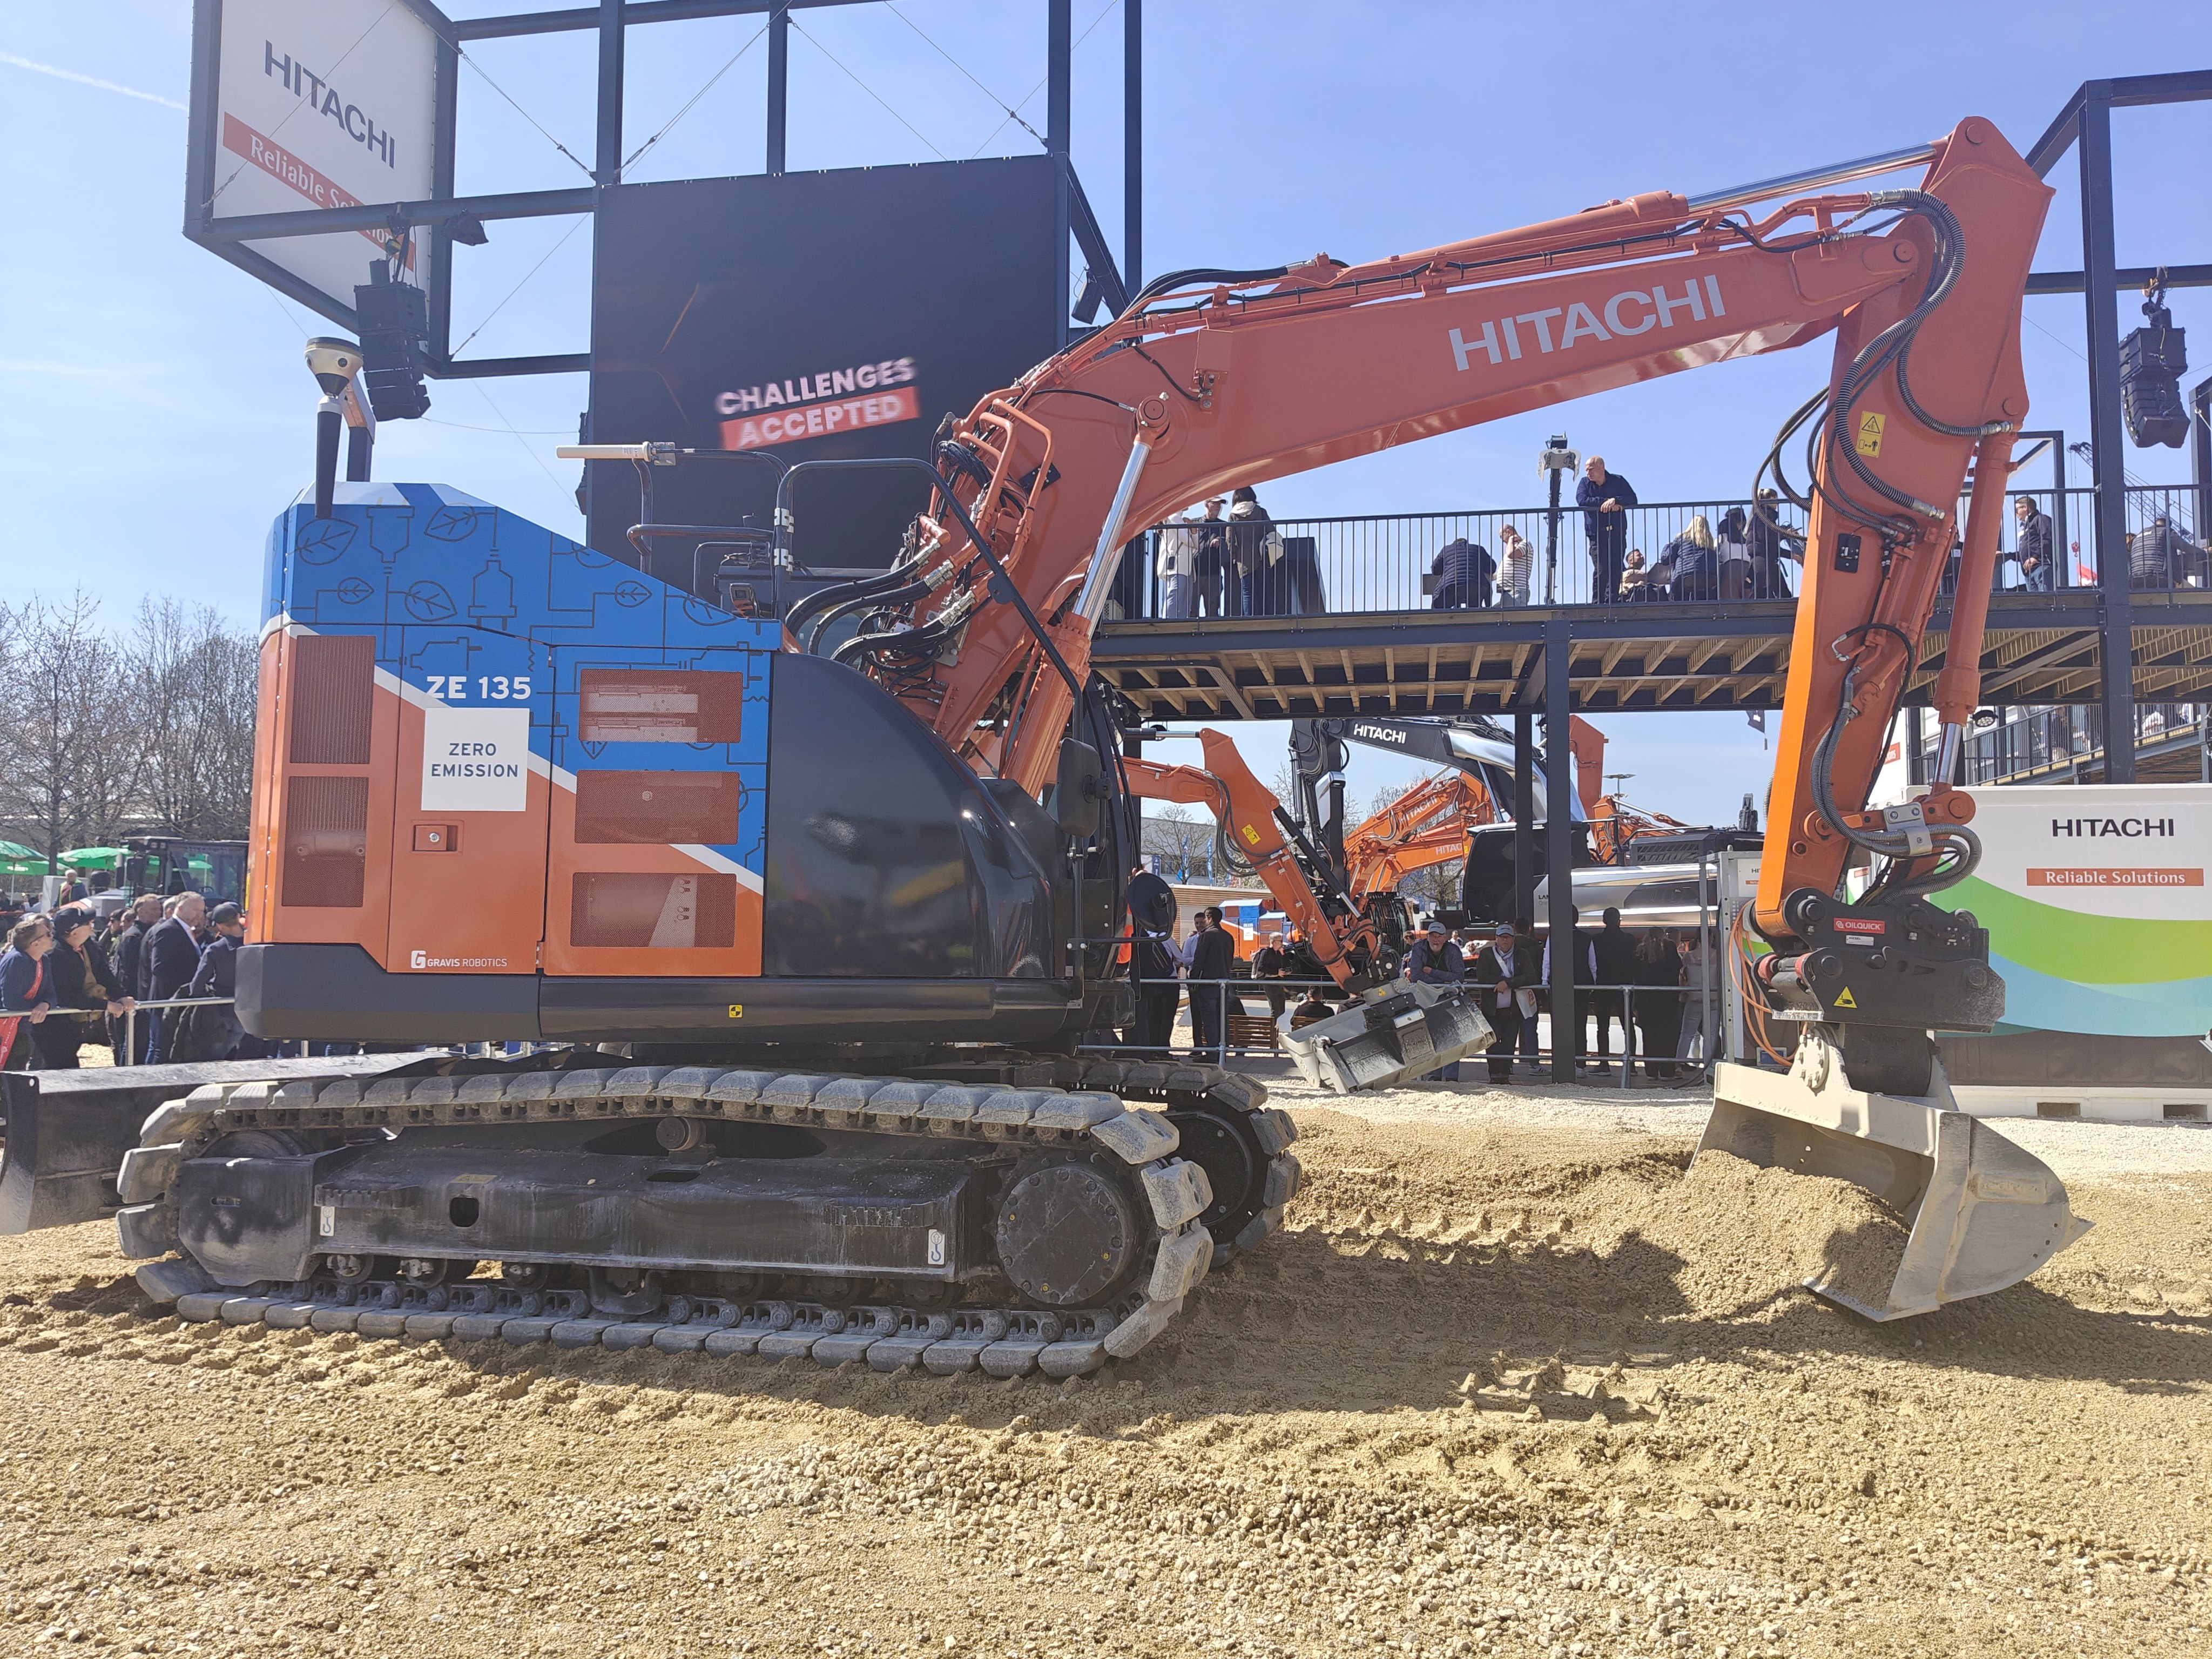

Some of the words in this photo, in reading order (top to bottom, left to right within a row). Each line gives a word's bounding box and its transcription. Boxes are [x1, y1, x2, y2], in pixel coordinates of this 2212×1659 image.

[265, 39, 395, 170] HITACHI
[250, 133, 324, 201] Reliable
[1448, 274, 1726, 372] HITACHI
[716, 356, 916, 415] CHALLENGES
[737, 395, 903, 449] ACCEPTED
[427, 676, 467, 699] ZE
[478, 676, 531, 699] 135
[1353, 723, 1406, 744] HITACHI
[449, 743, 497, 756] ZERO
[431, 764, 518, 778] EMISSION
[2052, 818, 2175, 837] HITACHI
[2045, 871, 2107, 884] Reliable
[2112, 871, 2186, 884] Solutions
[1845, 921, 1881, 930] OILQUICK
[427, 958, 460, 967] GRAVIS
[462, 958, 508, 967] ROBOTICS
